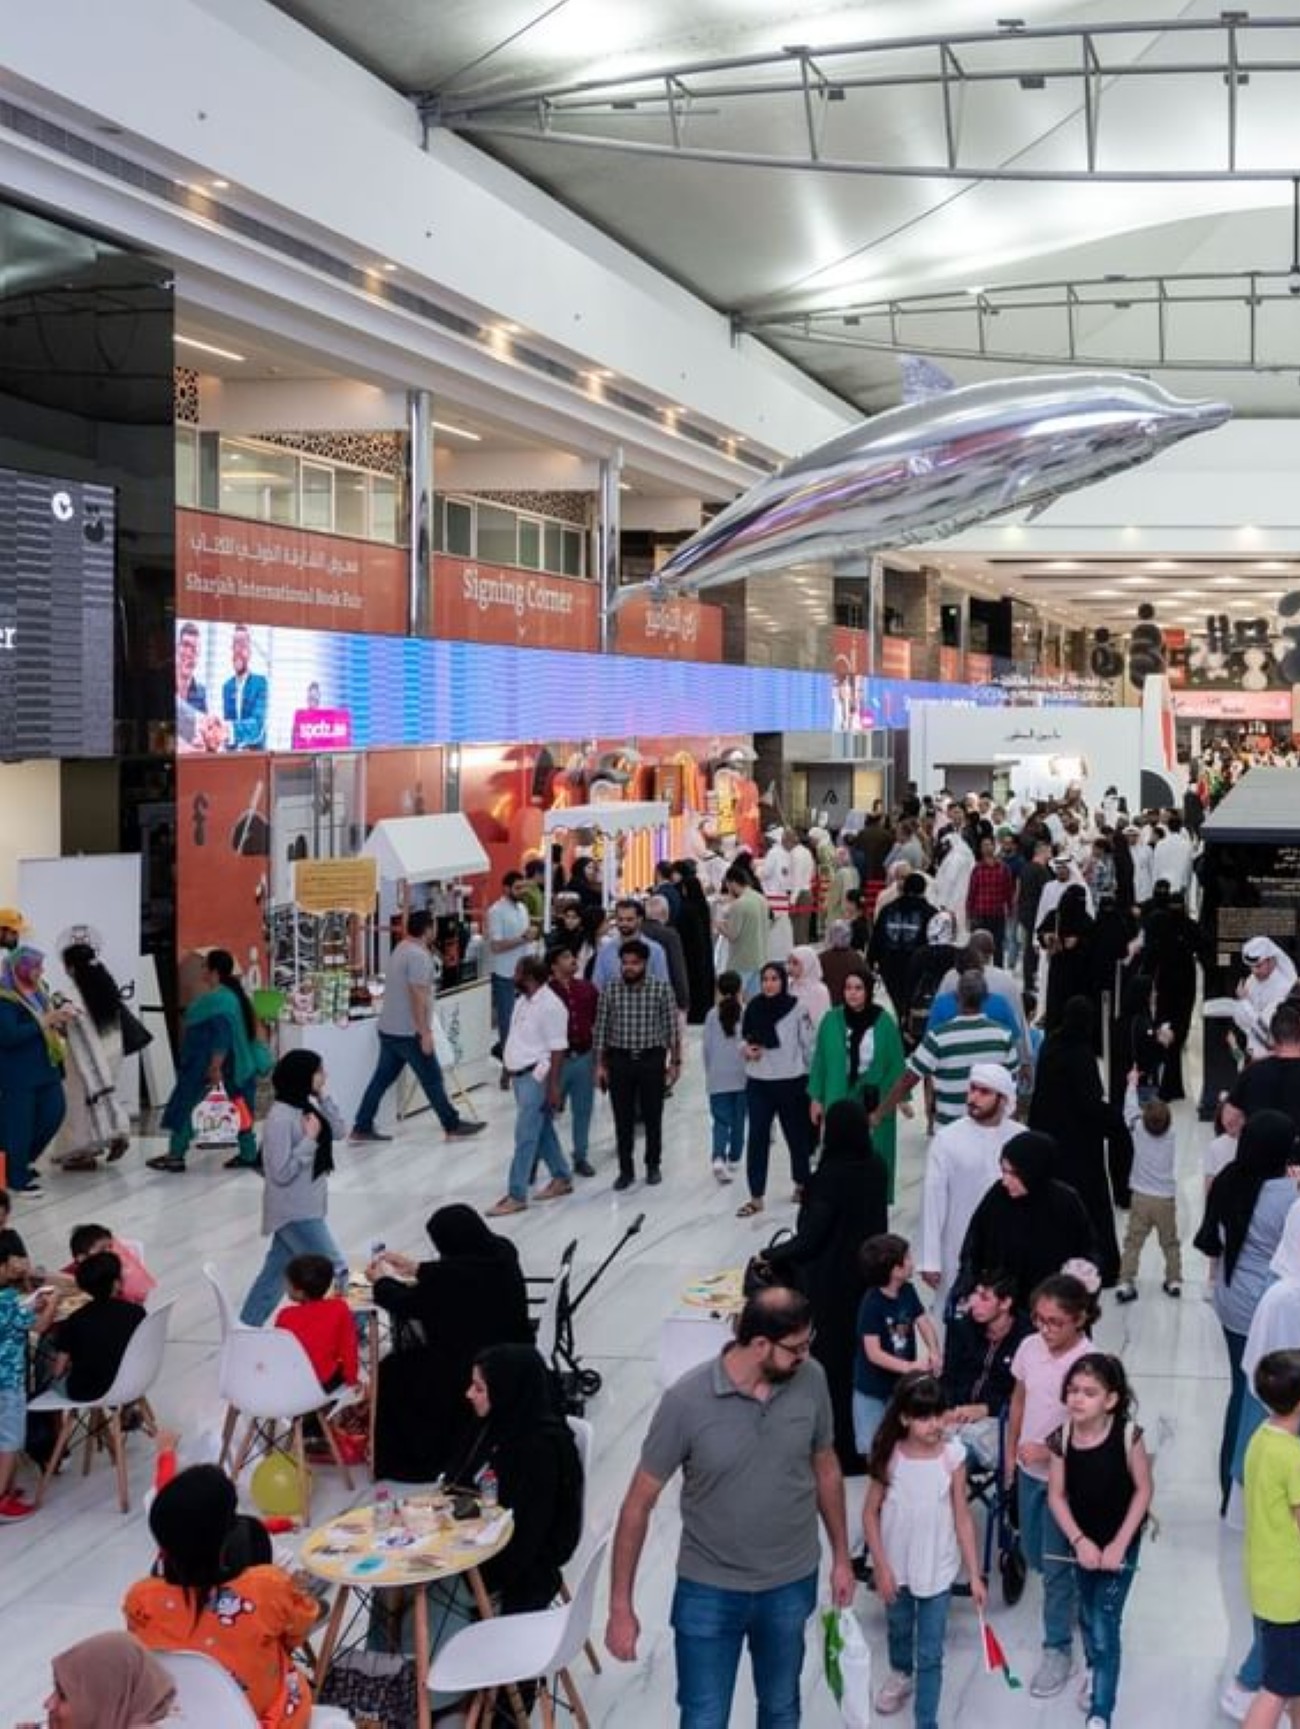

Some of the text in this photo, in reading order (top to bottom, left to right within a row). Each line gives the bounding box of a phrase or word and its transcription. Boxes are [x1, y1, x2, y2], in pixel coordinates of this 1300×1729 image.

[184, 570, 237, 598] Sharjah
[237, 573, 316, 604] International
[316, 586, 343, 607] Book
[463, 568, 574, 617] Signing Corner
